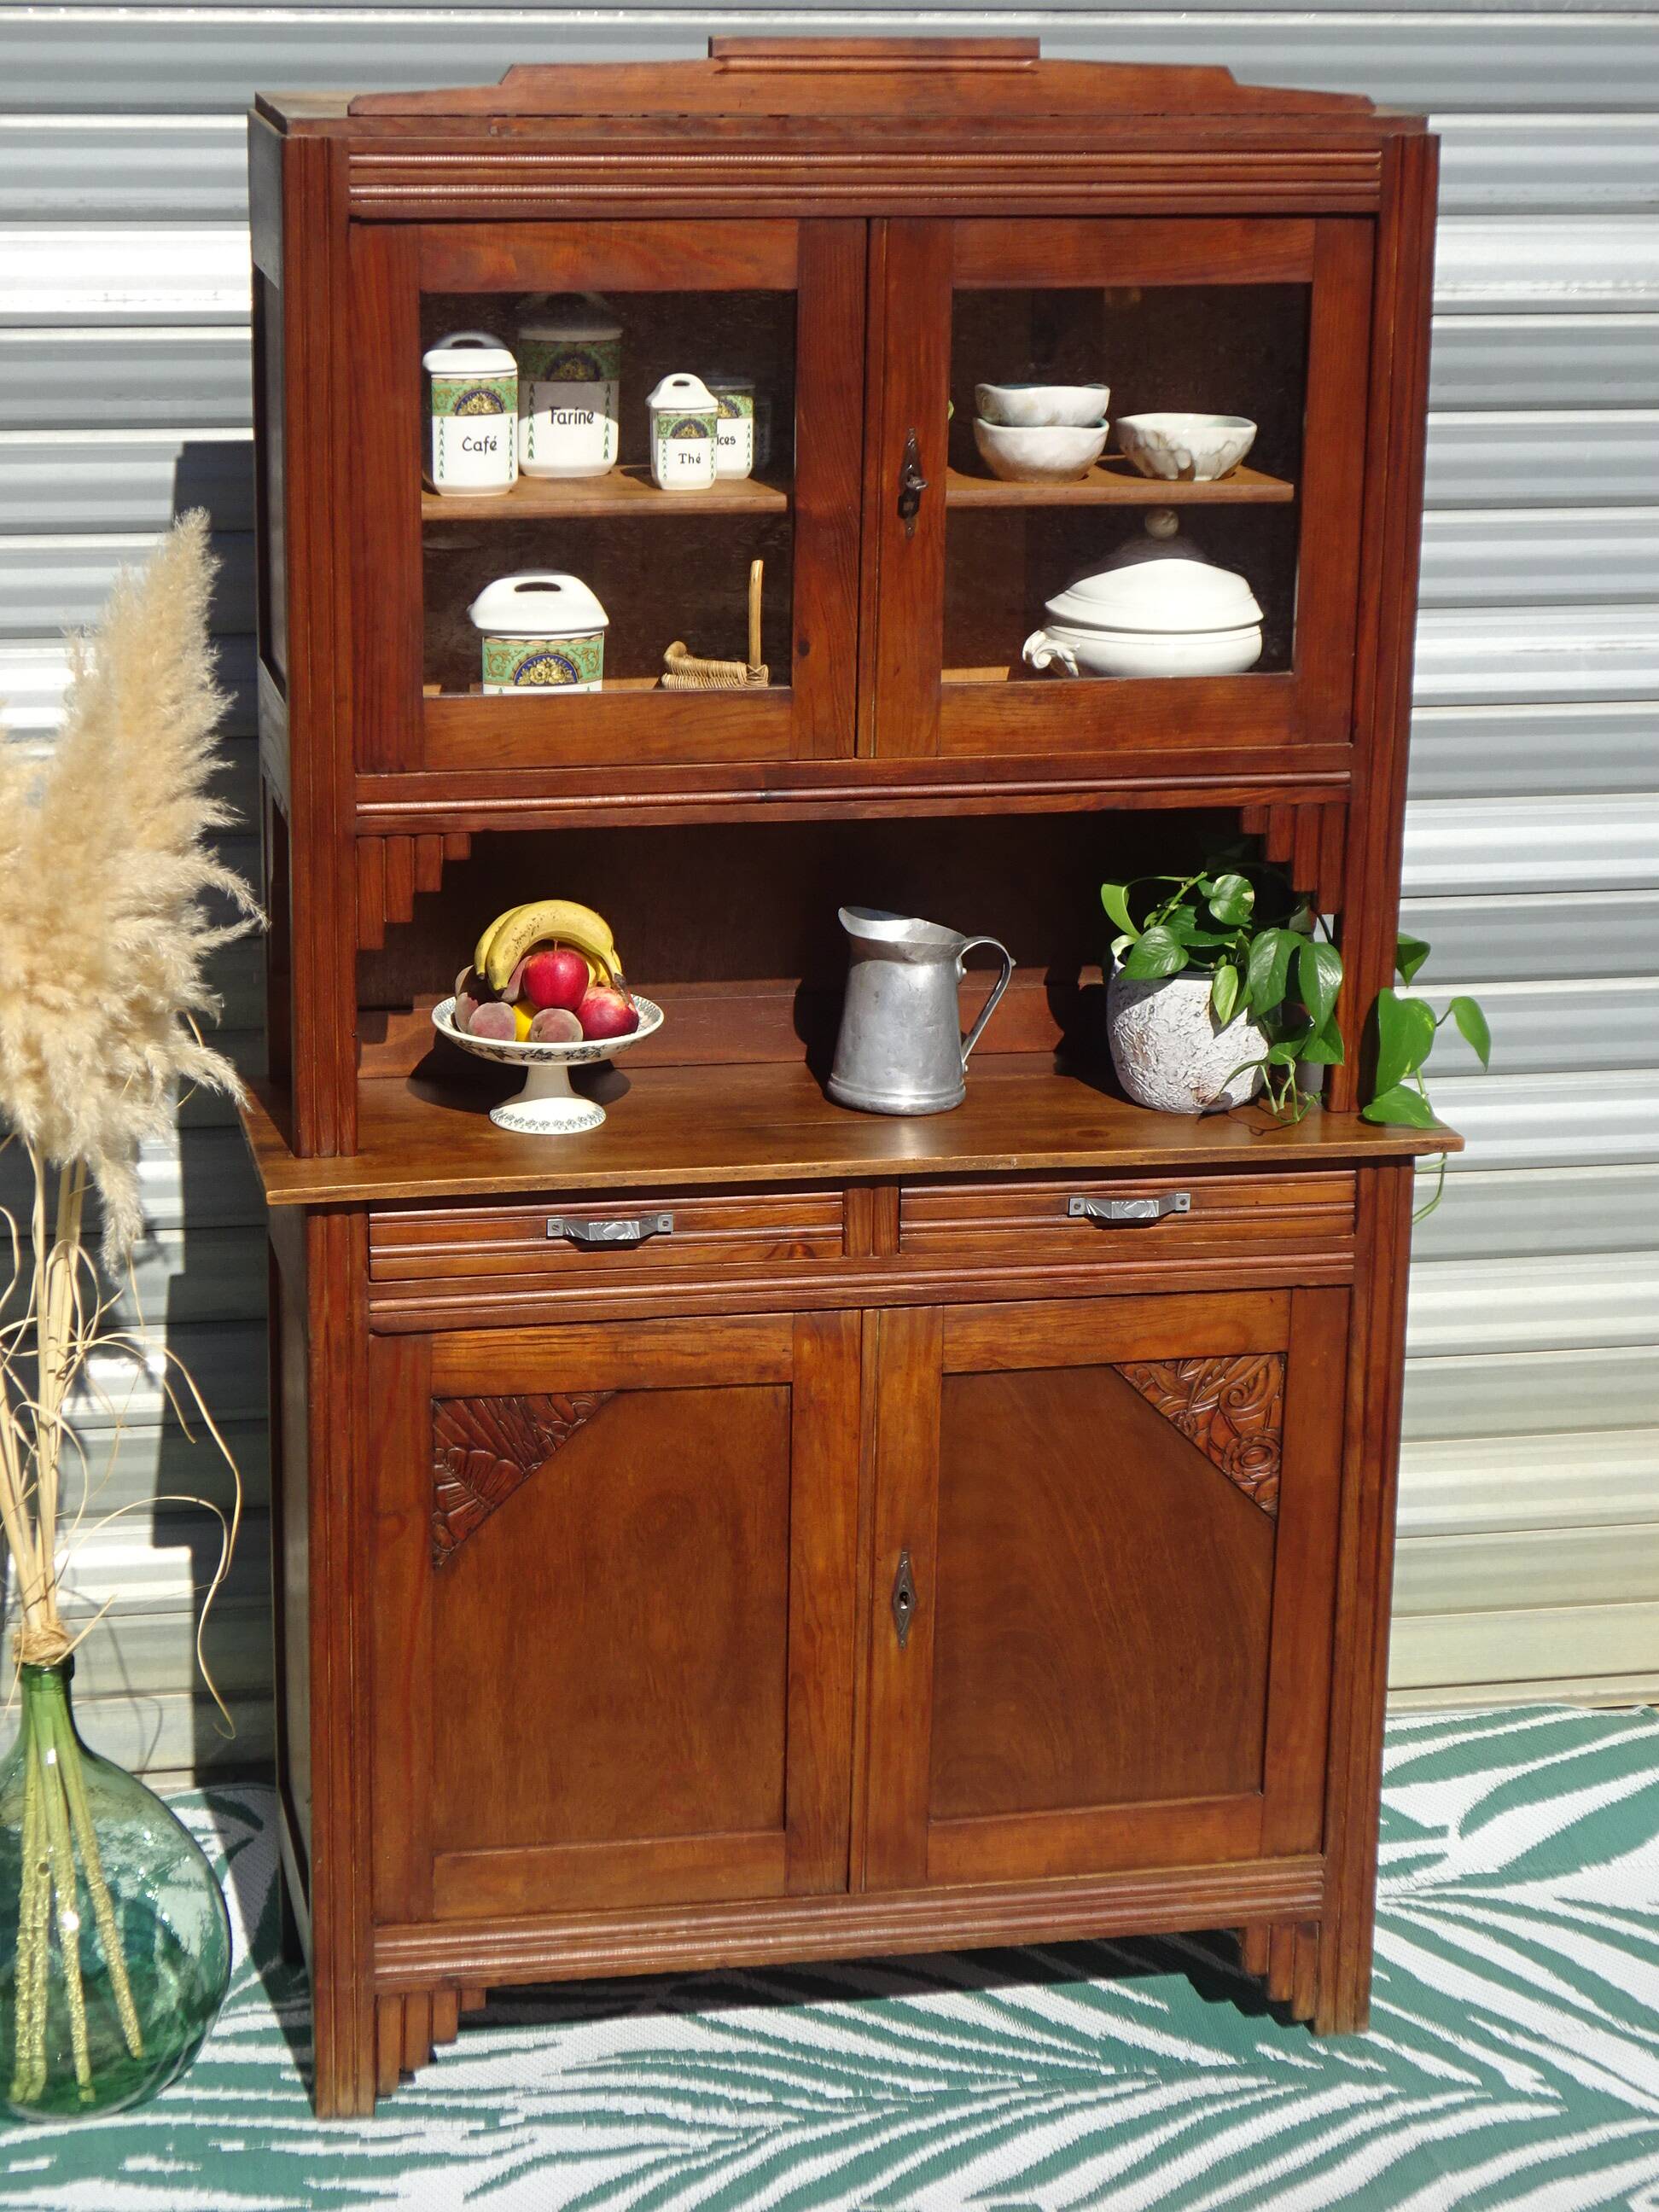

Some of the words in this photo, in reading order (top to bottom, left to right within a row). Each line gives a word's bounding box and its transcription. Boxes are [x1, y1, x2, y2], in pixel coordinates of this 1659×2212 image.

[550, 406, 594, 425] Farine
[462, 435, 497, 456] Café
[717, 434, 736, 445] ices
[678, 452, 701, 464] Thé
